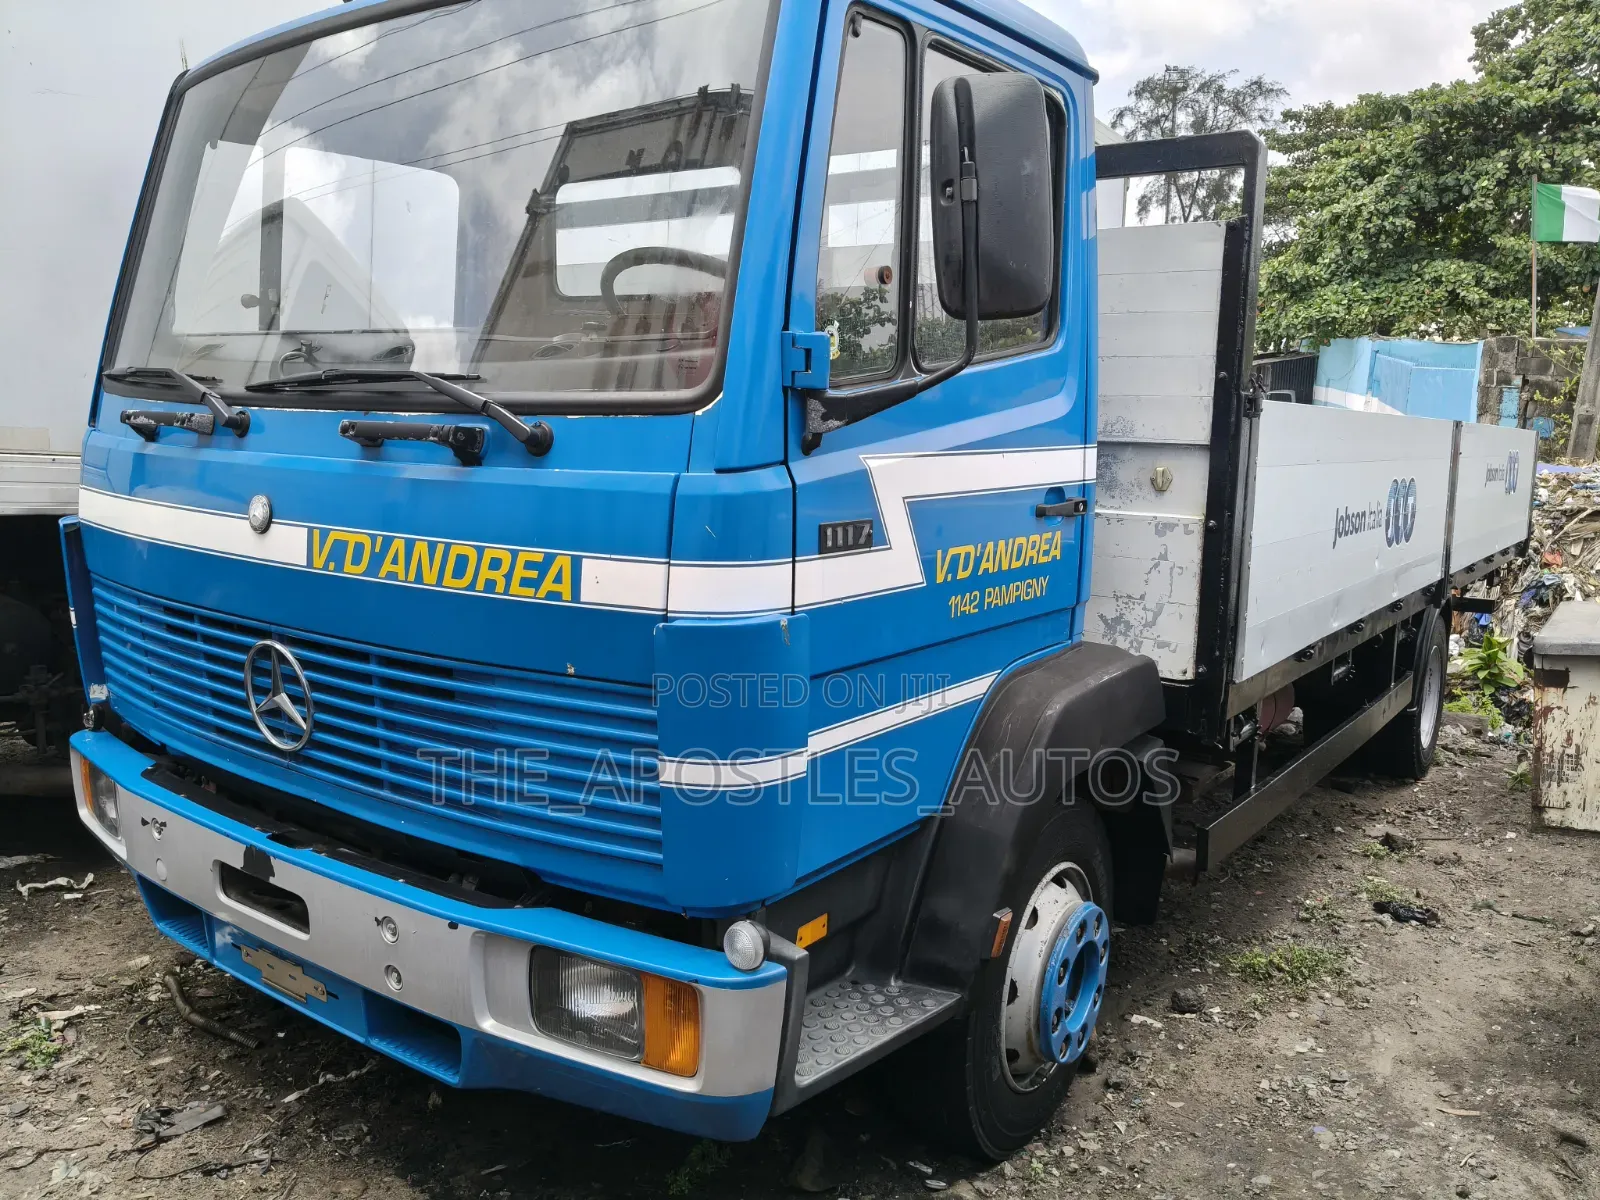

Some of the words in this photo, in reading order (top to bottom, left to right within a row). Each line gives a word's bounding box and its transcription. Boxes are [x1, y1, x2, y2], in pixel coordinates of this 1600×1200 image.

[825, 523, 874, 548] 1117
[1332, 505, 1367, 549] Jobson
[948, 590, 980, 619] 1142
[984, 575, 1050, 610] PAMPIGNY
